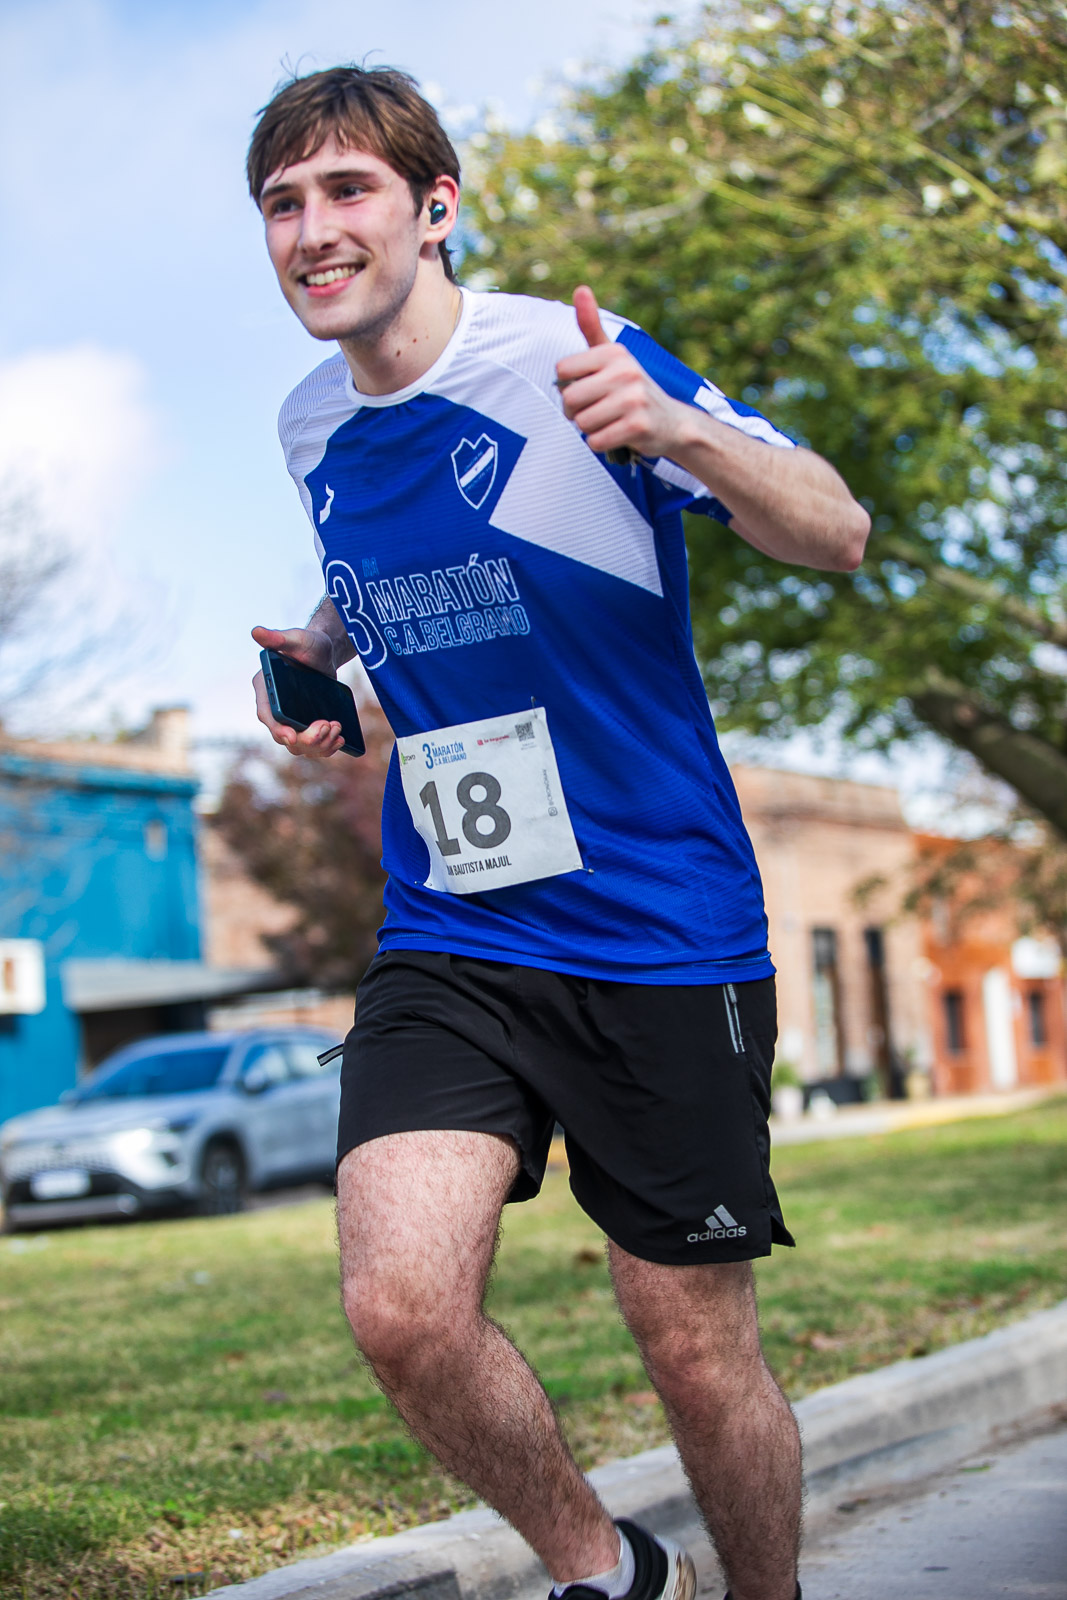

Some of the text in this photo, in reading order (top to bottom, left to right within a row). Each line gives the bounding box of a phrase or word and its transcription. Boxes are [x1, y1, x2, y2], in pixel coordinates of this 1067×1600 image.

[366, 554, 520, 624] MARATÓN
[326, 560, 388, 670] 3
[422, 743, 434, 770] 3
[432, 741, 465, 758] MARATÓN
[419, 771, 512, 857] 18
[453, 860, 485, 876] BAUTISTA
[485, 855, 512, 871] MAJUL
[687, 1225, 747, 1243] adidas
